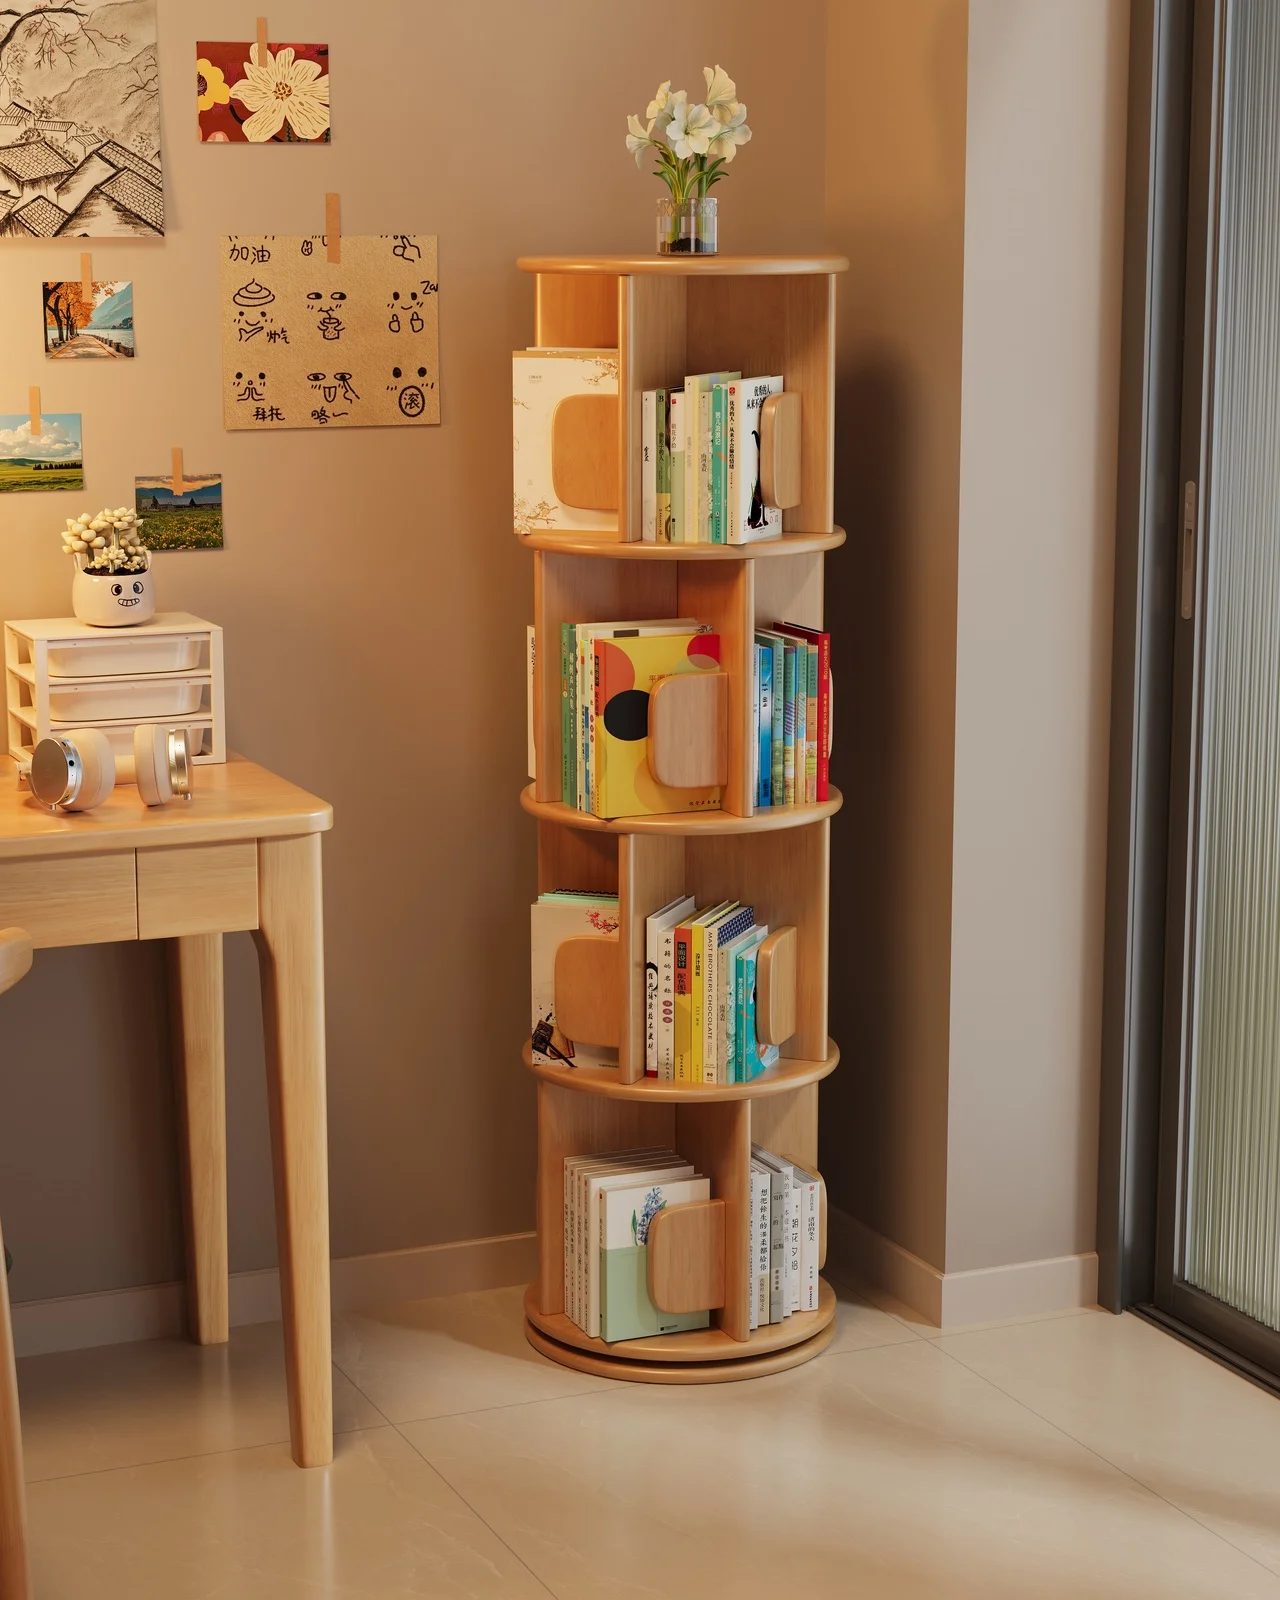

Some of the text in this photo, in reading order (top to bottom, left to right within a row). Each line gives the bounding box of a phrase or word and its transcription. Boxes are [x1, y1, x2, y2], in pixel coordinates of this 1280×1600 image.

[229, 244, 271, 264] 加油
[266, 328, 290, 344] 帅气
[404, 393, 420, 410] 滚
[253, 406, 285, 421] 拜托
[677, 943, 686, 997] 平面设计 配色图典
[808, 1216, 816, 1242] 济南的冬天
[791, 1217, 799, 1271] 朝花夕拾
